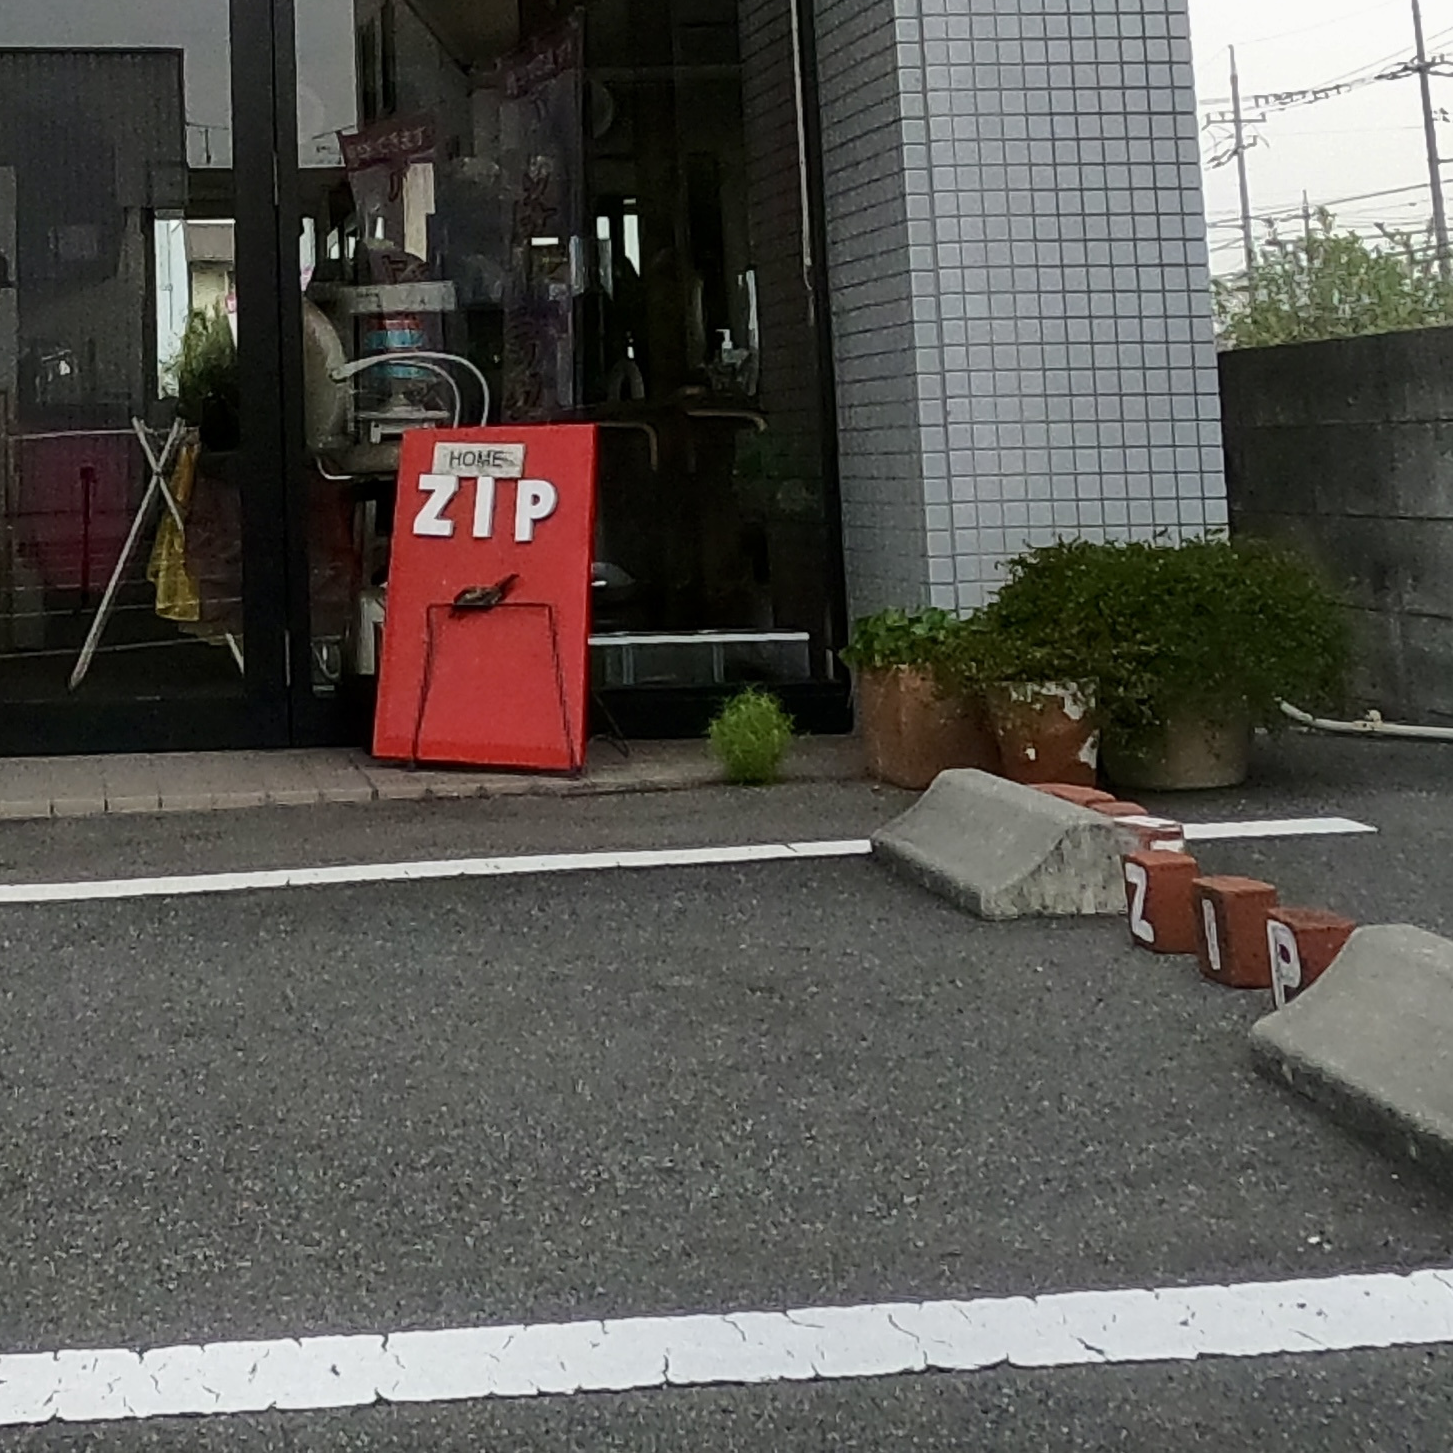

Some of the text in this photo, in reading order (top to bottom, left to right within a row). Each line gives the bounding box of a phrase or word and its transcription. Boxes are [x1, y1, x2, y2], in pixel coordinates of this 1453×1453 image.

[449, 450, 504, 469] HOME
[413, 473, 559, 543] ZIP
[1124, 861, 1302, 1010] ZIP
